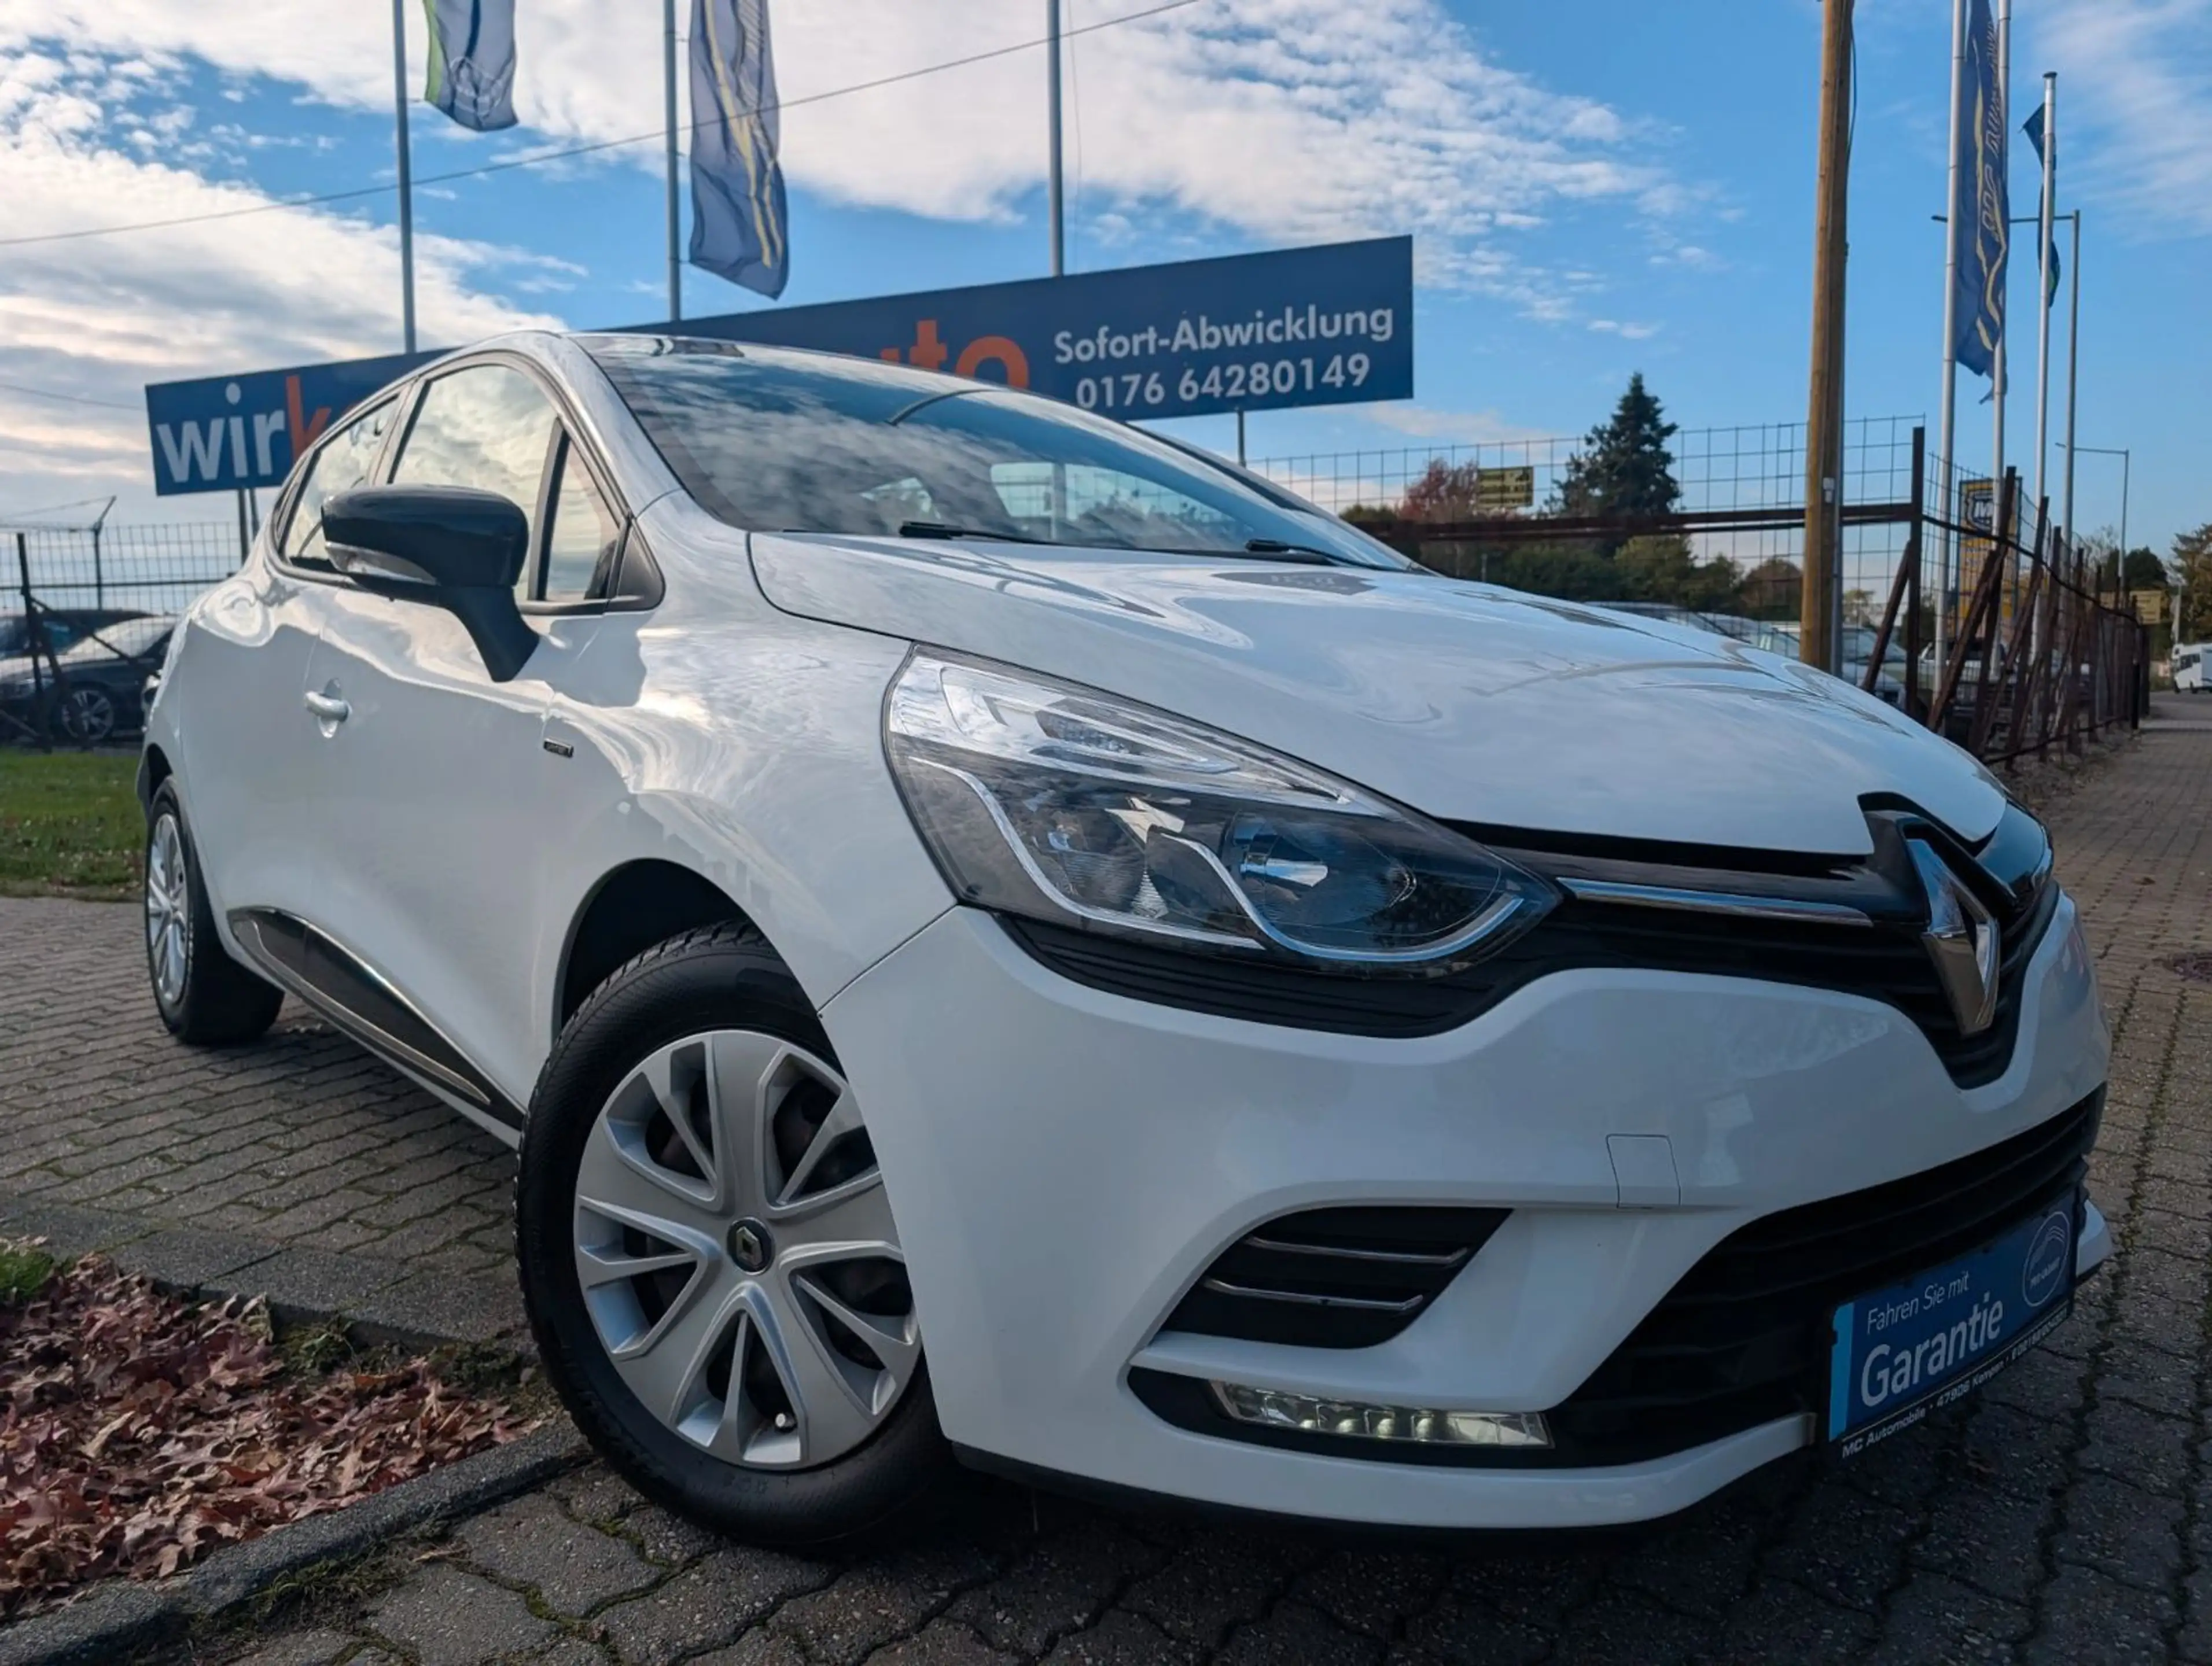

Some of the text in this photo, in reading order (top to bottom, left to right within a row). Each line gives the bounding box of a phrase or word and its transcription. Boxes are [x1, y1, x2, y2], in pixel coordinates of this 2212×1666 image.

[1054, 304, 1394, 364] Sofort-Abwicklung
[1076, 353, 1370, 410] 0176 64280149
[1867, 1270, 1970, 1336] Fahren Sie mit
[1860, 1292, 2004, 1407] Garantie
[1866, 1406, 1926, 1446] Automobile
